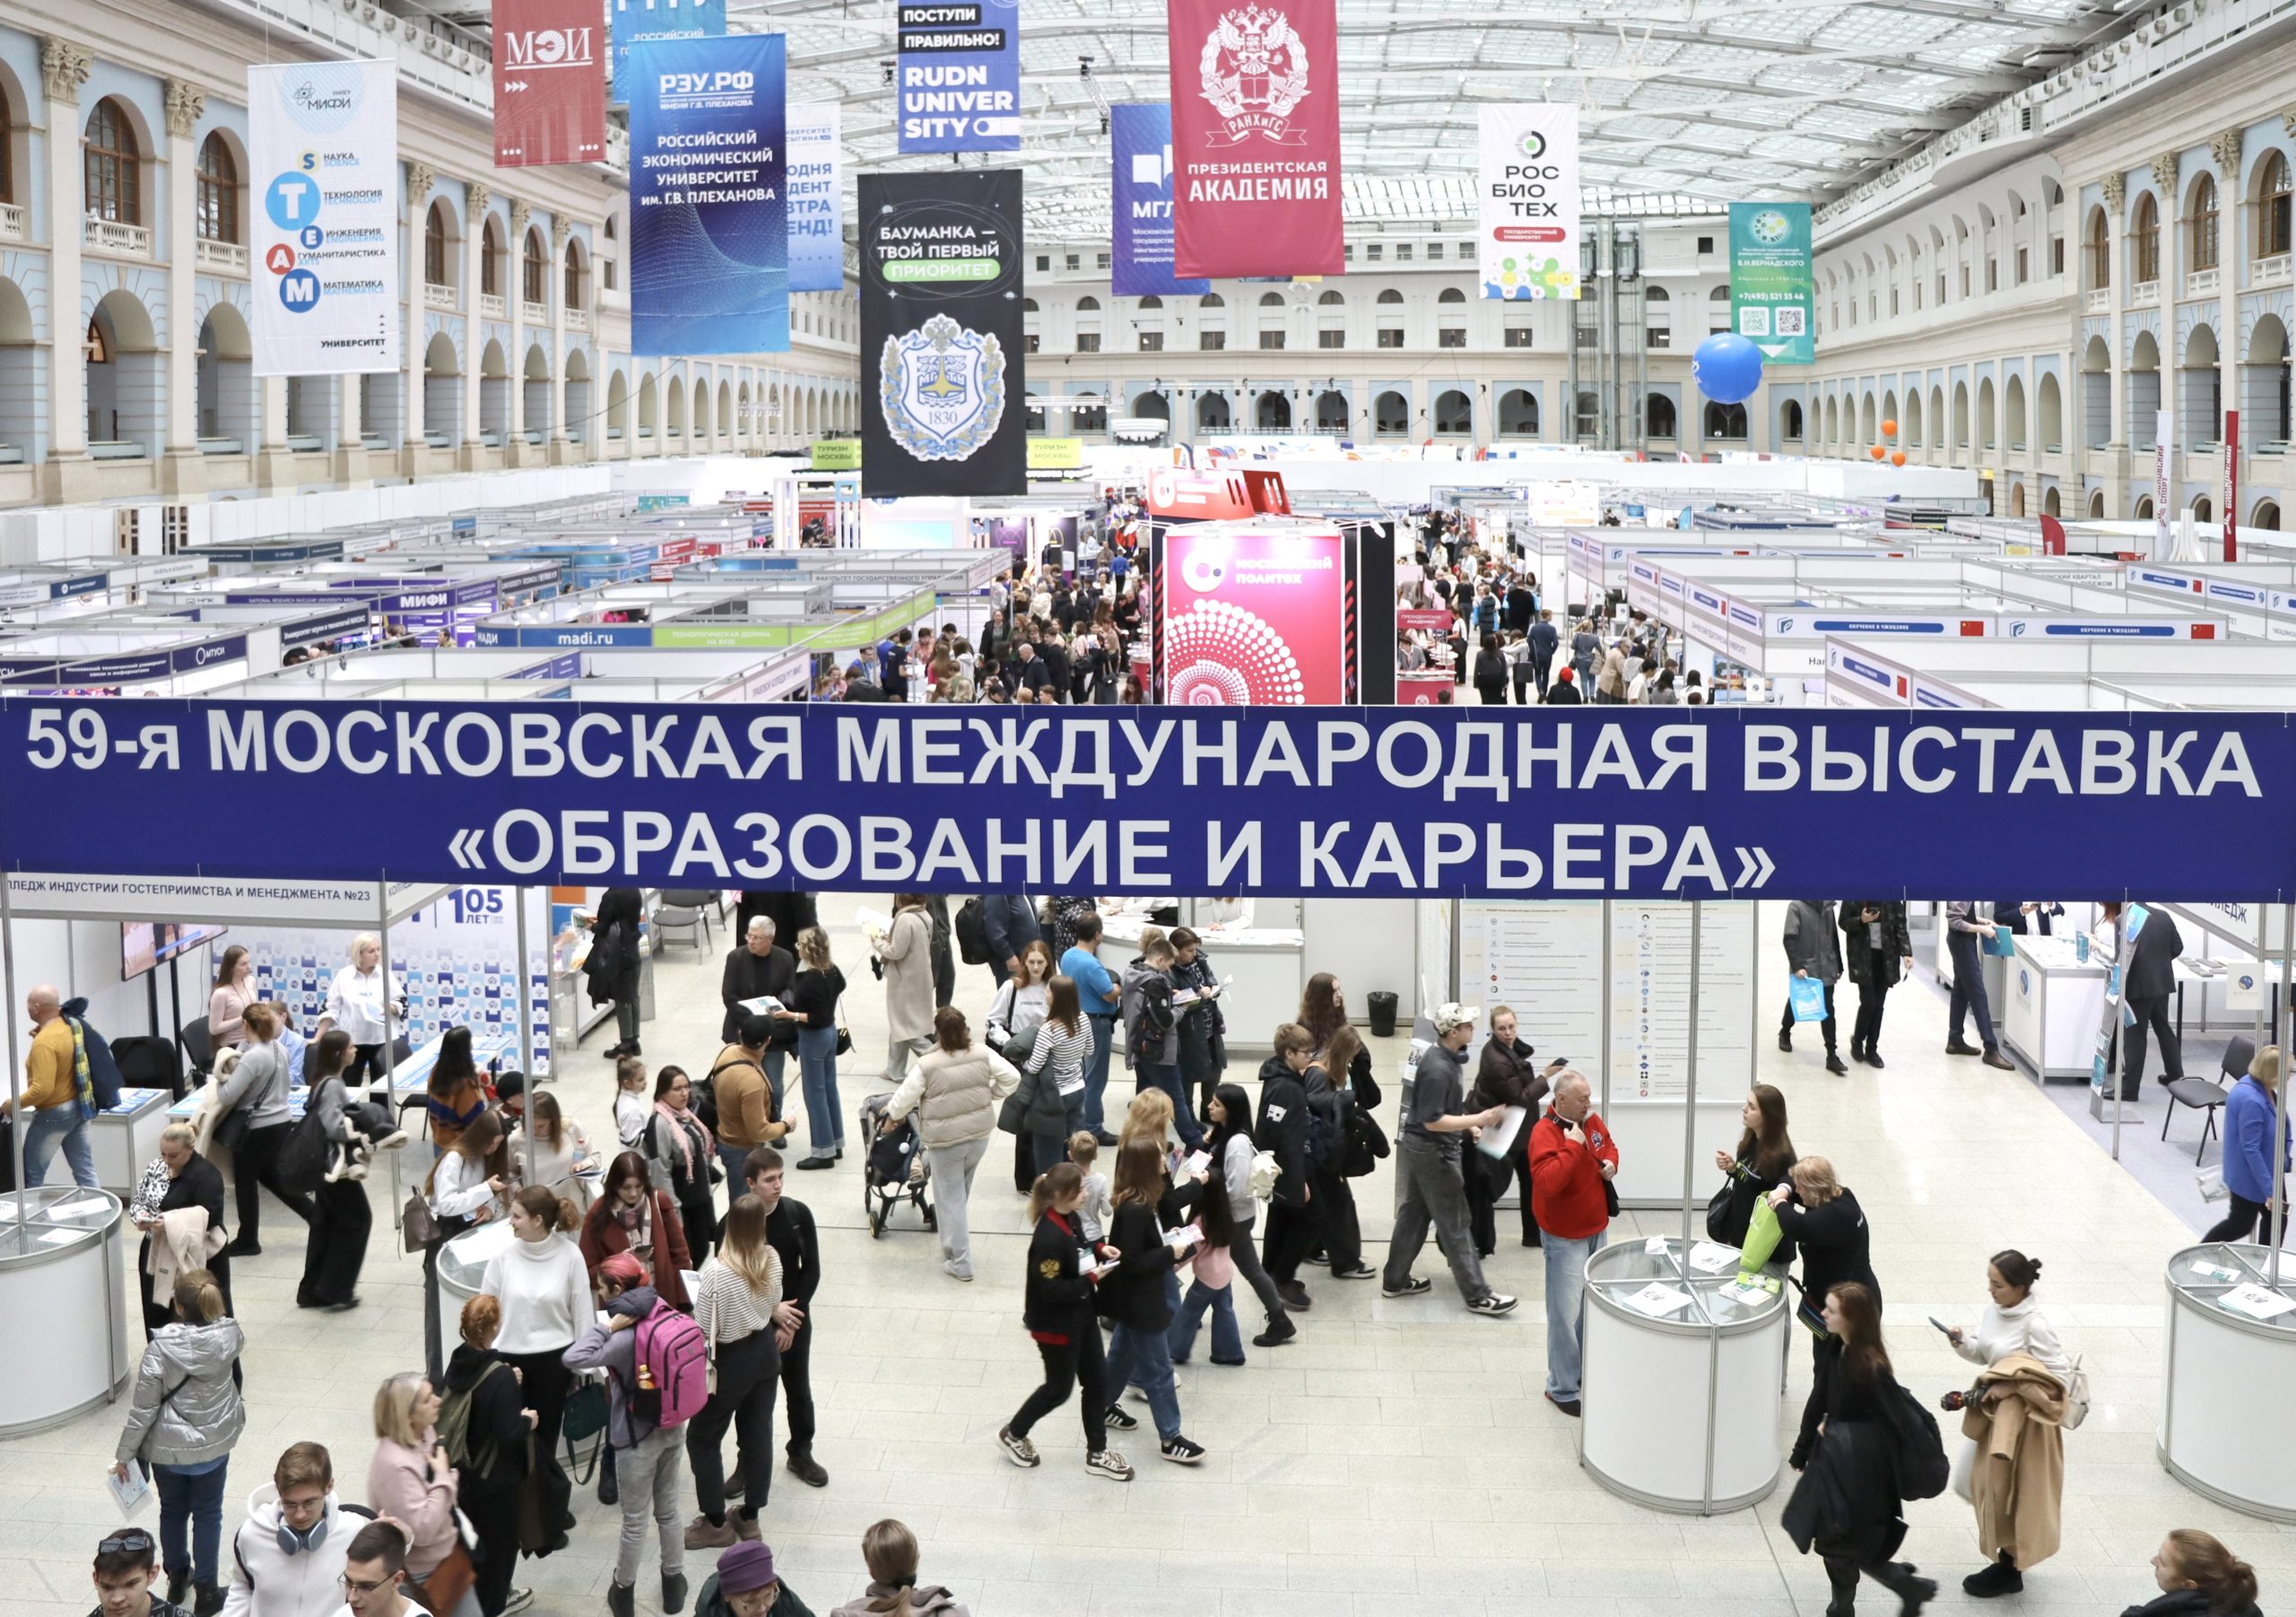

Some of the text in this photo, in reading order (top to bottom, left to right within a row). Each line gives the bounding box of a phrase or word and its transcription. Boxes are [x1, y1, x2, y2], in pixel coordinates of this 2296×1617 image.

[904, 8, 976, 22] ПОСТУПИ
[505, 27, 593, 65] МЭИ
[905, 33, 1000, 48] ПРАВИЛЬНО!
[660, 71, 754, 93] РЭУ.РФ
[905, 65, 987, 87] RUDN
[308, 97, 351, 110] МИФИ
[660, 101, 689, 110] ИМЕНИ
[706, 99, 753, 108] ПЛЕХАНОВА
[905, 91, 1013, 112] UNIVER
[904, 117, 970, 139] SITY
[1229, 114, 1283, 133] РАНХиГС
[657, 130, 757, 148] РОССИЙСКИЙ
[302, 153, 316, 170] S
[324, 152, 354, 161] НАУКА
[324, 159, 359, 167] SCIENCE
[642, 148, 773, 168] ЭКОНОМИЧЕСКИЙ
[1187, 161, 1327, 174] ПРЕЗИДЕНТСКАЯ
[1506, 166, 1560, 179] РОС
[657, 170, 759, 186] УНИВЕРСИТЕТ
[324, 190, 383, 200] ТЕХНОЛОГИЯ
[641, 188, 776, 205] им. Г.В. ПЛЕХАНОВА
[1188, 178, 1328, 202] АКАДЕМИЯ
[1492, 184, 1545, 197] БИО
[279, 182, 307, 220] T
[324, 197, 383, 205] TECHNOLOGY
[1132, 201, 1174, 218] МГЛ
[1509, 203, 1558, 216] ТЕХ
[326, 228, 381, 237] ИНЖЕНЕРИЯ
[787, 219, 833, 237] ЕНД!
[880, 226, 976, 241] БАУМАНКА
[306, 229, 317, 246] E
[326, 234, 385, 244] ENGINEERING
[298, 249, 386, 260] ГУМАНИТАРИСТИКА
[877, 240, 1000, 259] ТВОЙ ПЕРВЫЙ
[272, 248, 291, 269] A
[891, 263, 992, 278] ПРИОРИТЕТ
[286, 277, 314, 302] M
[324, 280, 383, 290] МАТЕМАТИКА
[324, 286, 385, 295] MATHEMATICS
[321, 338, 386, 348] УНИВЕРСИТЕТ
[927, 412, 958, 425] 1830
[400, 593, 448, 608] МИФИ
[557, 631, 614, 647] madi.ru
[28, 708, 2263, 803] 59-я МОСКОВСКАЯ МЕЖДУНАРОДНАЯ ВЫСТАВКА
[448, 808, 1776, 891] «ОБРАЗОВАНИЕ И КАРЬЕРА»
[49, 882, 118, 893] ИНДУСТРИИ
[122, 883, 232, 896] ГОСТЕПРИИМСТВА
[236, 888, 243, 897] И
[248, 888, 340, 900] МЕНЕДЖМЕНТА
[344, 891, 370, 900] №23
[448, 887, 504, 924] 105
[465, 914, 490, 925] ЛЕТ
